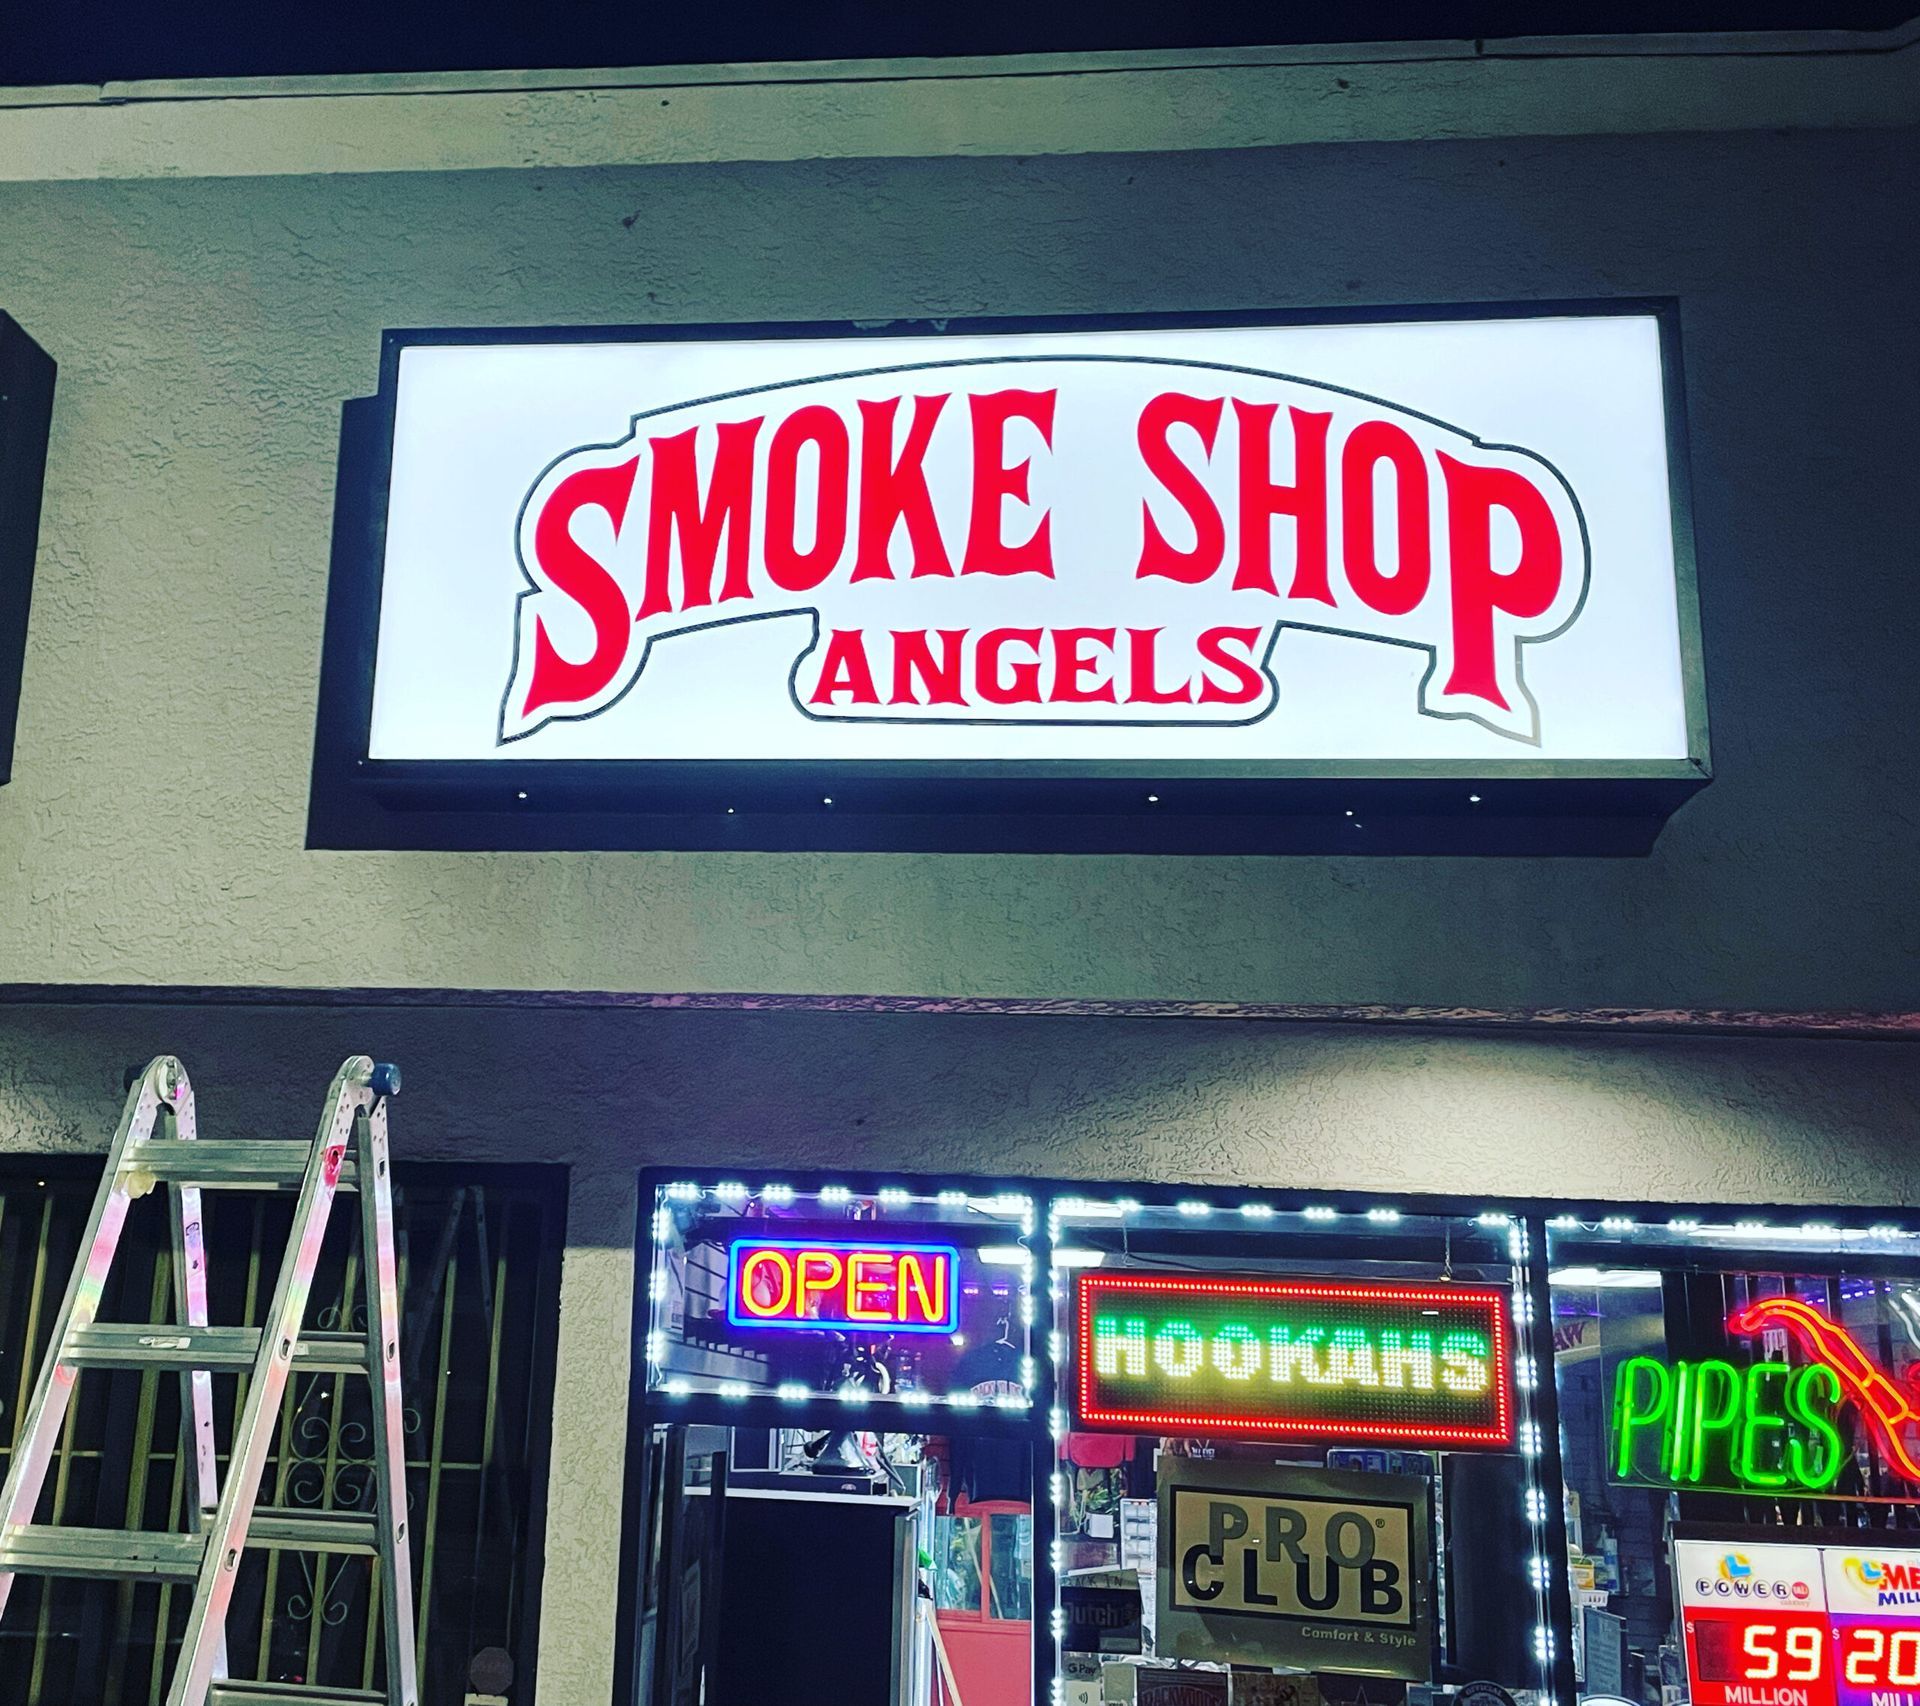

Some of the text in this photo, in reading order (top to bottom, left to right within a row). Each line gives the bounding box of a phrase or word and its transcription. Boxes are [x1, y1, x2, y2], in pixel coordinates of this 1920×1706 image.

[522, 388, 1562, 719] SMOKE SHOP
[807, 626, 1264, 706] ANGELS
[743, 1251, 944, 1321] OPEN
[1096, 1319, 1488, 1392] HOOKAHS
[1616, 1356, 1841, 1488] PIPES
[1183, 1544, 1402, 1615] CLUB
[1302, 1627, 1416, 1648] Comfort & Style
[1686, 1621, 1822, 1680] $ 59
[1832, 1628, 1840, 1640] $
[1724, 1685, 1808, 1706] MILLION
